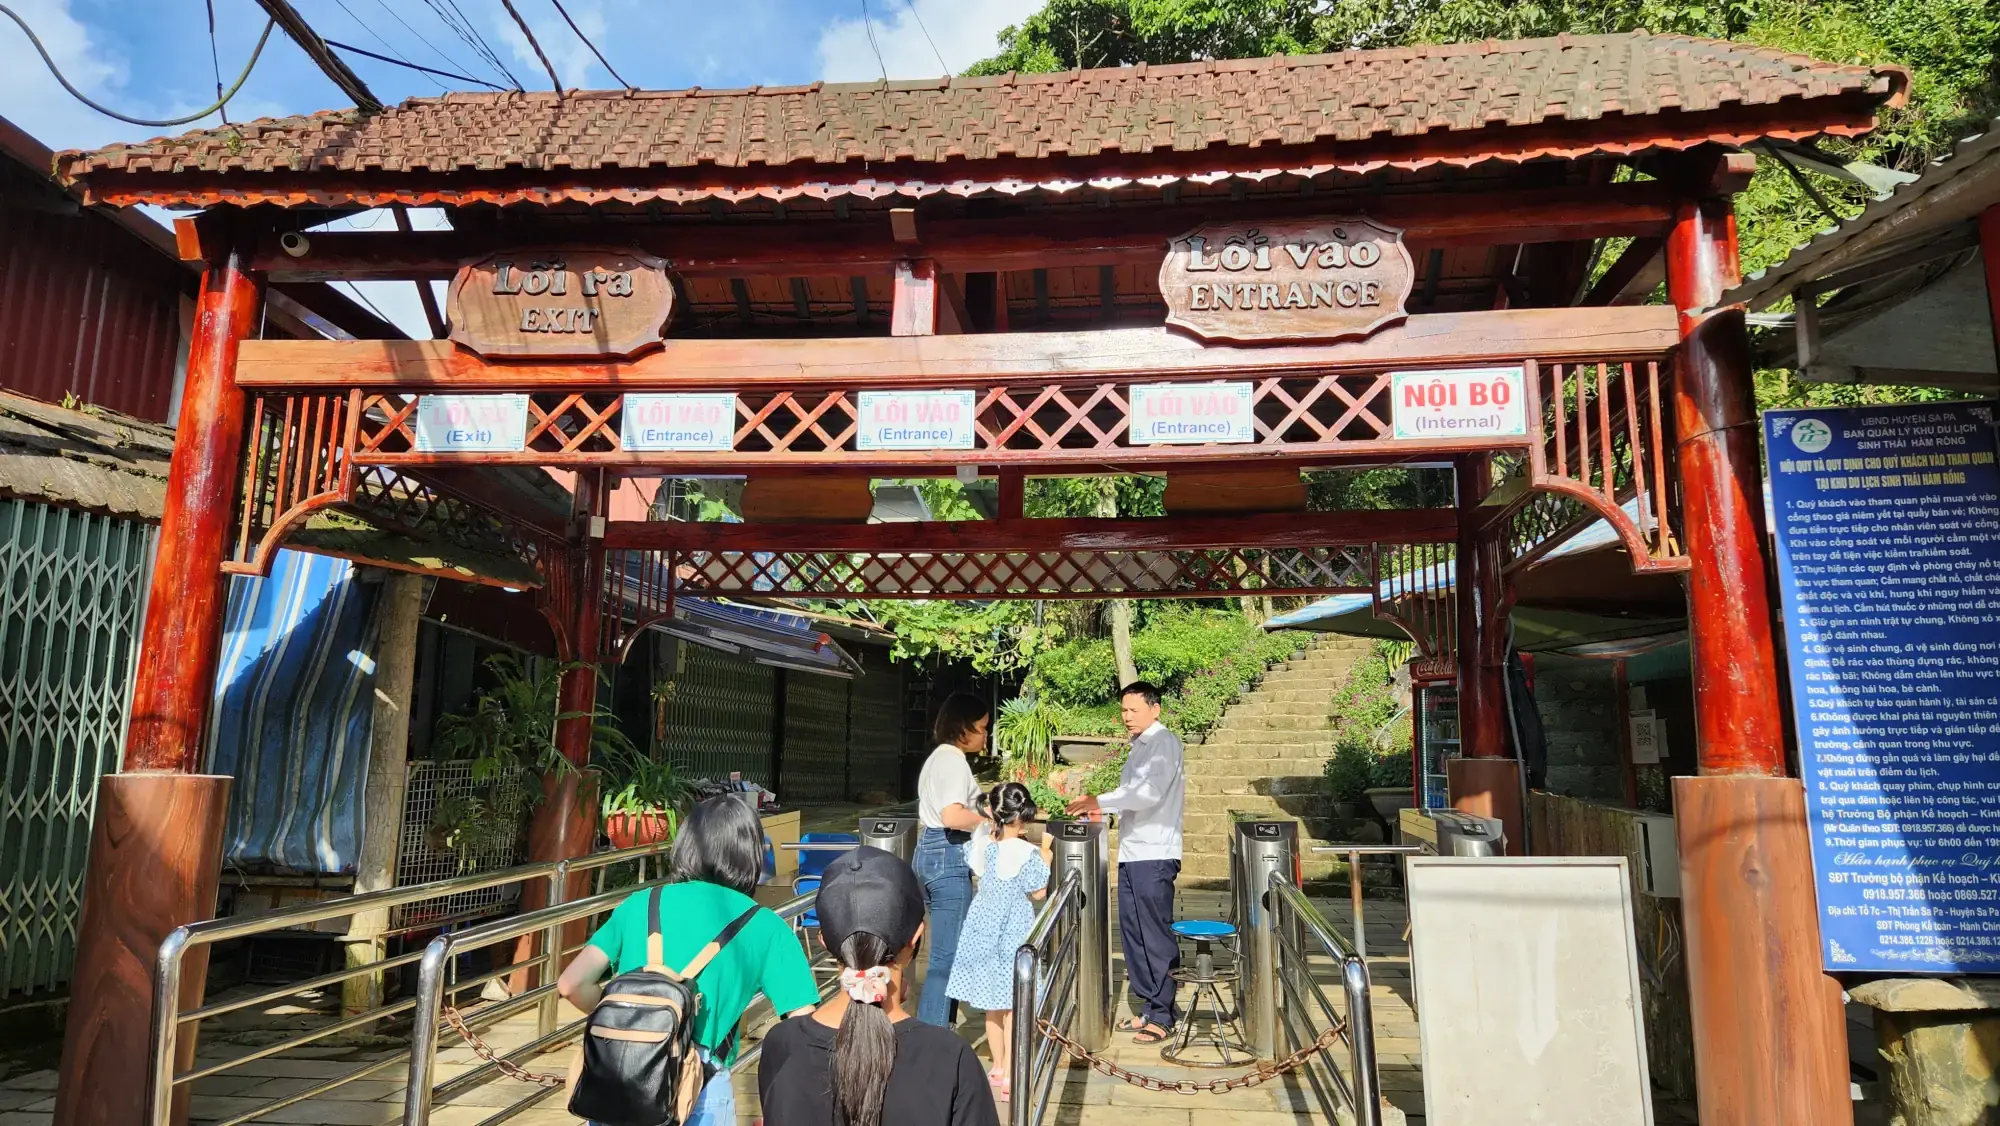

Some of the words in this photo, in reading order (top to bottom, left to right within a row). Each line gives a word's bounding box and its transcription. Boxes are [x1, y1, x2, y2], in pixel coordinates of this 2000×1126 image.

[1186, 229, 1272, 272] Lối
[1285, 228, 1381, 270] vào
[492, 256, 566, 296] Lối
[582, 271, 633, 297] ra
[1190, 280, 1380, 311] ENTRANCE
[519, 307, 598, 333] EXIT
[1404, 379, 1457, 412] NỘI
[1469, 377, 1510, 410] BỘ
[1415, 414, 1501, 432] (Internal)
[1861, 416, 1889, 425] UBND
[1891, 414, 1925, 424] HUYỆN
[1928, 413, 1941, 422] SA
[878, 427, 953, 442] (Entrance)
[1151, 420, 1231, 436] (Entrance)
[1843, 429, 1864, 438] BAN
[1913, 426, 1934, 435] KHU
[1937, 425, 1951, 433] DU
[1954, 424, 1976, 433] LỊCH
[446, 430, 492, 444] (Exit)
[641, 429, 714, 444] (Entrance)
[1857, 441, 1880, 449] SINH
[1796, 460, 1812, 473] QUY
[1813, 456, 1825, 471] VÀ
[1826, 458, 1842, 472] QUY
[1843, 458, 1863, 472] ĐỊNH
[1864, 457, 1880, 469] CHO
[1929, 452, 1944, 466] VÀO
[1946, 452, 1970, 465] THAM
[1972, 451, 1993, 465] QUAN
[1815, 477, 1828, 492] TẠI
[1830, 477, 1847, 489] KHU
[1848, 476, 1859, 488] DU
[1861, 475, 1879, 490] LỊCH
[1881, 474, 1900, 487] SINH
[1786, 500, 1794, 508] 1.
[1796, 499, 1815, 509] Quý
[1818, 499, 1846, 507] khách
[1848, 498, 1866, 506] vào
[1791, 552, 1810, 560] trên
[1812, 552, 1827, 561] tay
[1863, 550, 1882, 559] việc
[1949, 547, 1971, 555] soát.
[1799, 618, 1808, 626] 3.
[1860, 617, 1881, 625] ninh
[1883, 616, 1898, 626] trật
[1901, 617, 1912, 626] tự
[1914, 616, 1945, 625] chung,
[1948, 614, 1978, 624] Không
[1802, 645, 1811, 653] 4.
[1833, 644, 1844, 654] vệ
[1847, 644, 1867, 652] sinh
[1869, 644, 1902, 653] chung,
[1904, 643, 1913, 651] đi
[1916, 643, 1927, 652] vệ
[1929, 642, 1950, 650] sinh
[1952, 642, 1976, 652] đúng
[1847, 658, 1863, 666] rác
[1865, 657, 1883, 665] vào
[1886, 657, 1914, 667] thùng
[1917, 656, 1943, 666] đựng
[1946, 656, 1964, 664] rác,
[1967, 655, 1998, 665] không
[1814, 740, 1850, 750] trường,
[1878, 741, 1902, 749] quan
[1904, 740, 1929, 749] trong
[1932, 739, 1950, 747] khu
[1952, 740, 1973, 748] vực.
[1817, 768, 1832, 777] vật
[1857, 768, 1876, 776] trên
[1920, 768, 1939, 777] lịch.
[1820, 796, 1836, 805] trại
[1879, 796, 1901, 805] hoặc
[1923, 795, 1934, 805] hệ
[1936, 796, 1959, 805] công
[1962, 796, 1978, 804] tác,
[1825, 837, 1855, 845] 9.Thời
[1907, 840, 1922, 848] vụ:
[1924, 838, 1936, 846] từ
[1938, 838, 1961, 846] 6h00
[1963, 837, 1981, 846] đến
[1960, 853, 1991, 868] Quý
[1928, 889, 1952, 899] hoặc
[1828, 906, 1840, 916] Địa
[1887, 906, 1900, 917] Thị
[1921, 906, 1930, 915] Sa
[1933, 906, 1943, 915] Pa
[1950, 907, 1974, 918] Huyện
[1976, 907, 1986, 916] Sa
[1989, 907, 1999, 916] Pa
